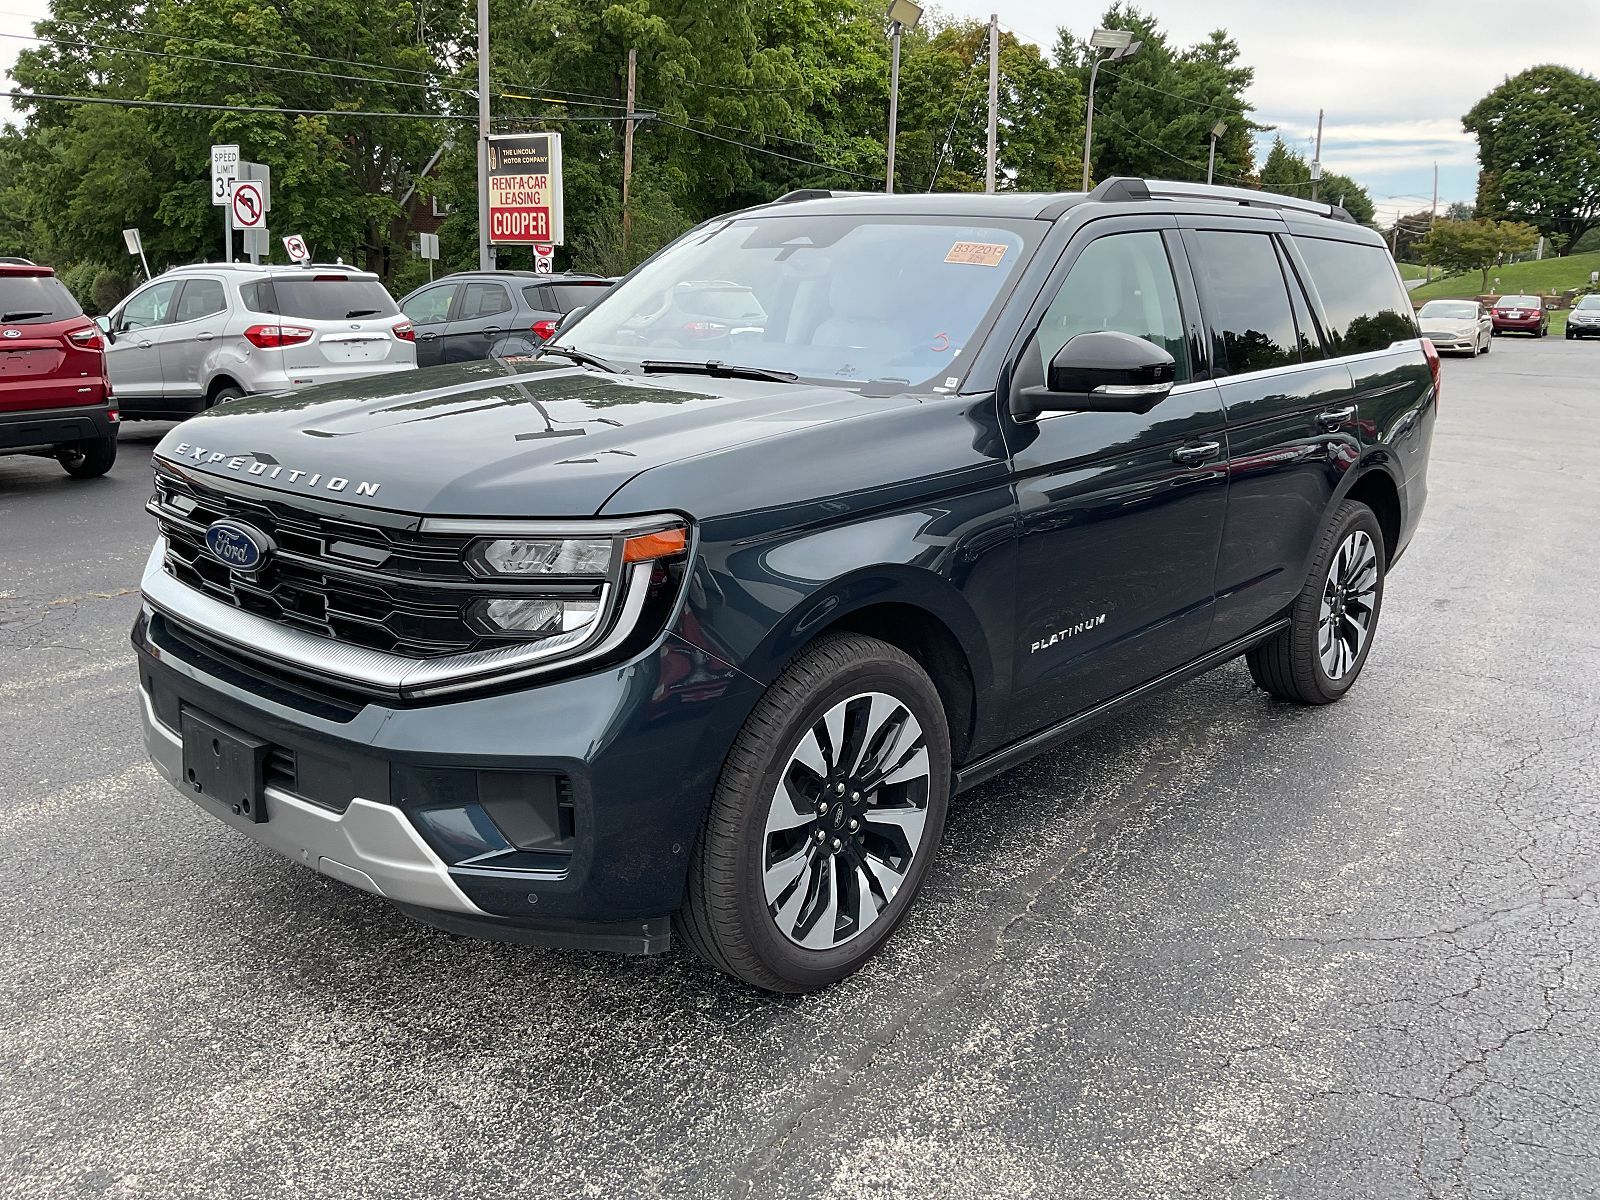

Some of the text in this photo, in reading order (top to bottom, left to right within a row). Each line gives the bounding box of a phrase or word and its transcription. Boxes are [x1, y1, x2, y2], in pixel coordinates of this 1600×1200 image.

[214, 153, 237, 162] SPEED
[503, 156, 548, 165] MOTOR COMPANY
[216, 165, 234, 174] LIMIT
[500, 191, 541, 205] LEASING
[493, 212, 547, 235] COOPER
[174, 442, 381, 497] EXPEDITION
[214, 528, 249, 563] Ford
[1030, 613, 1106, 654] PLATINUM
